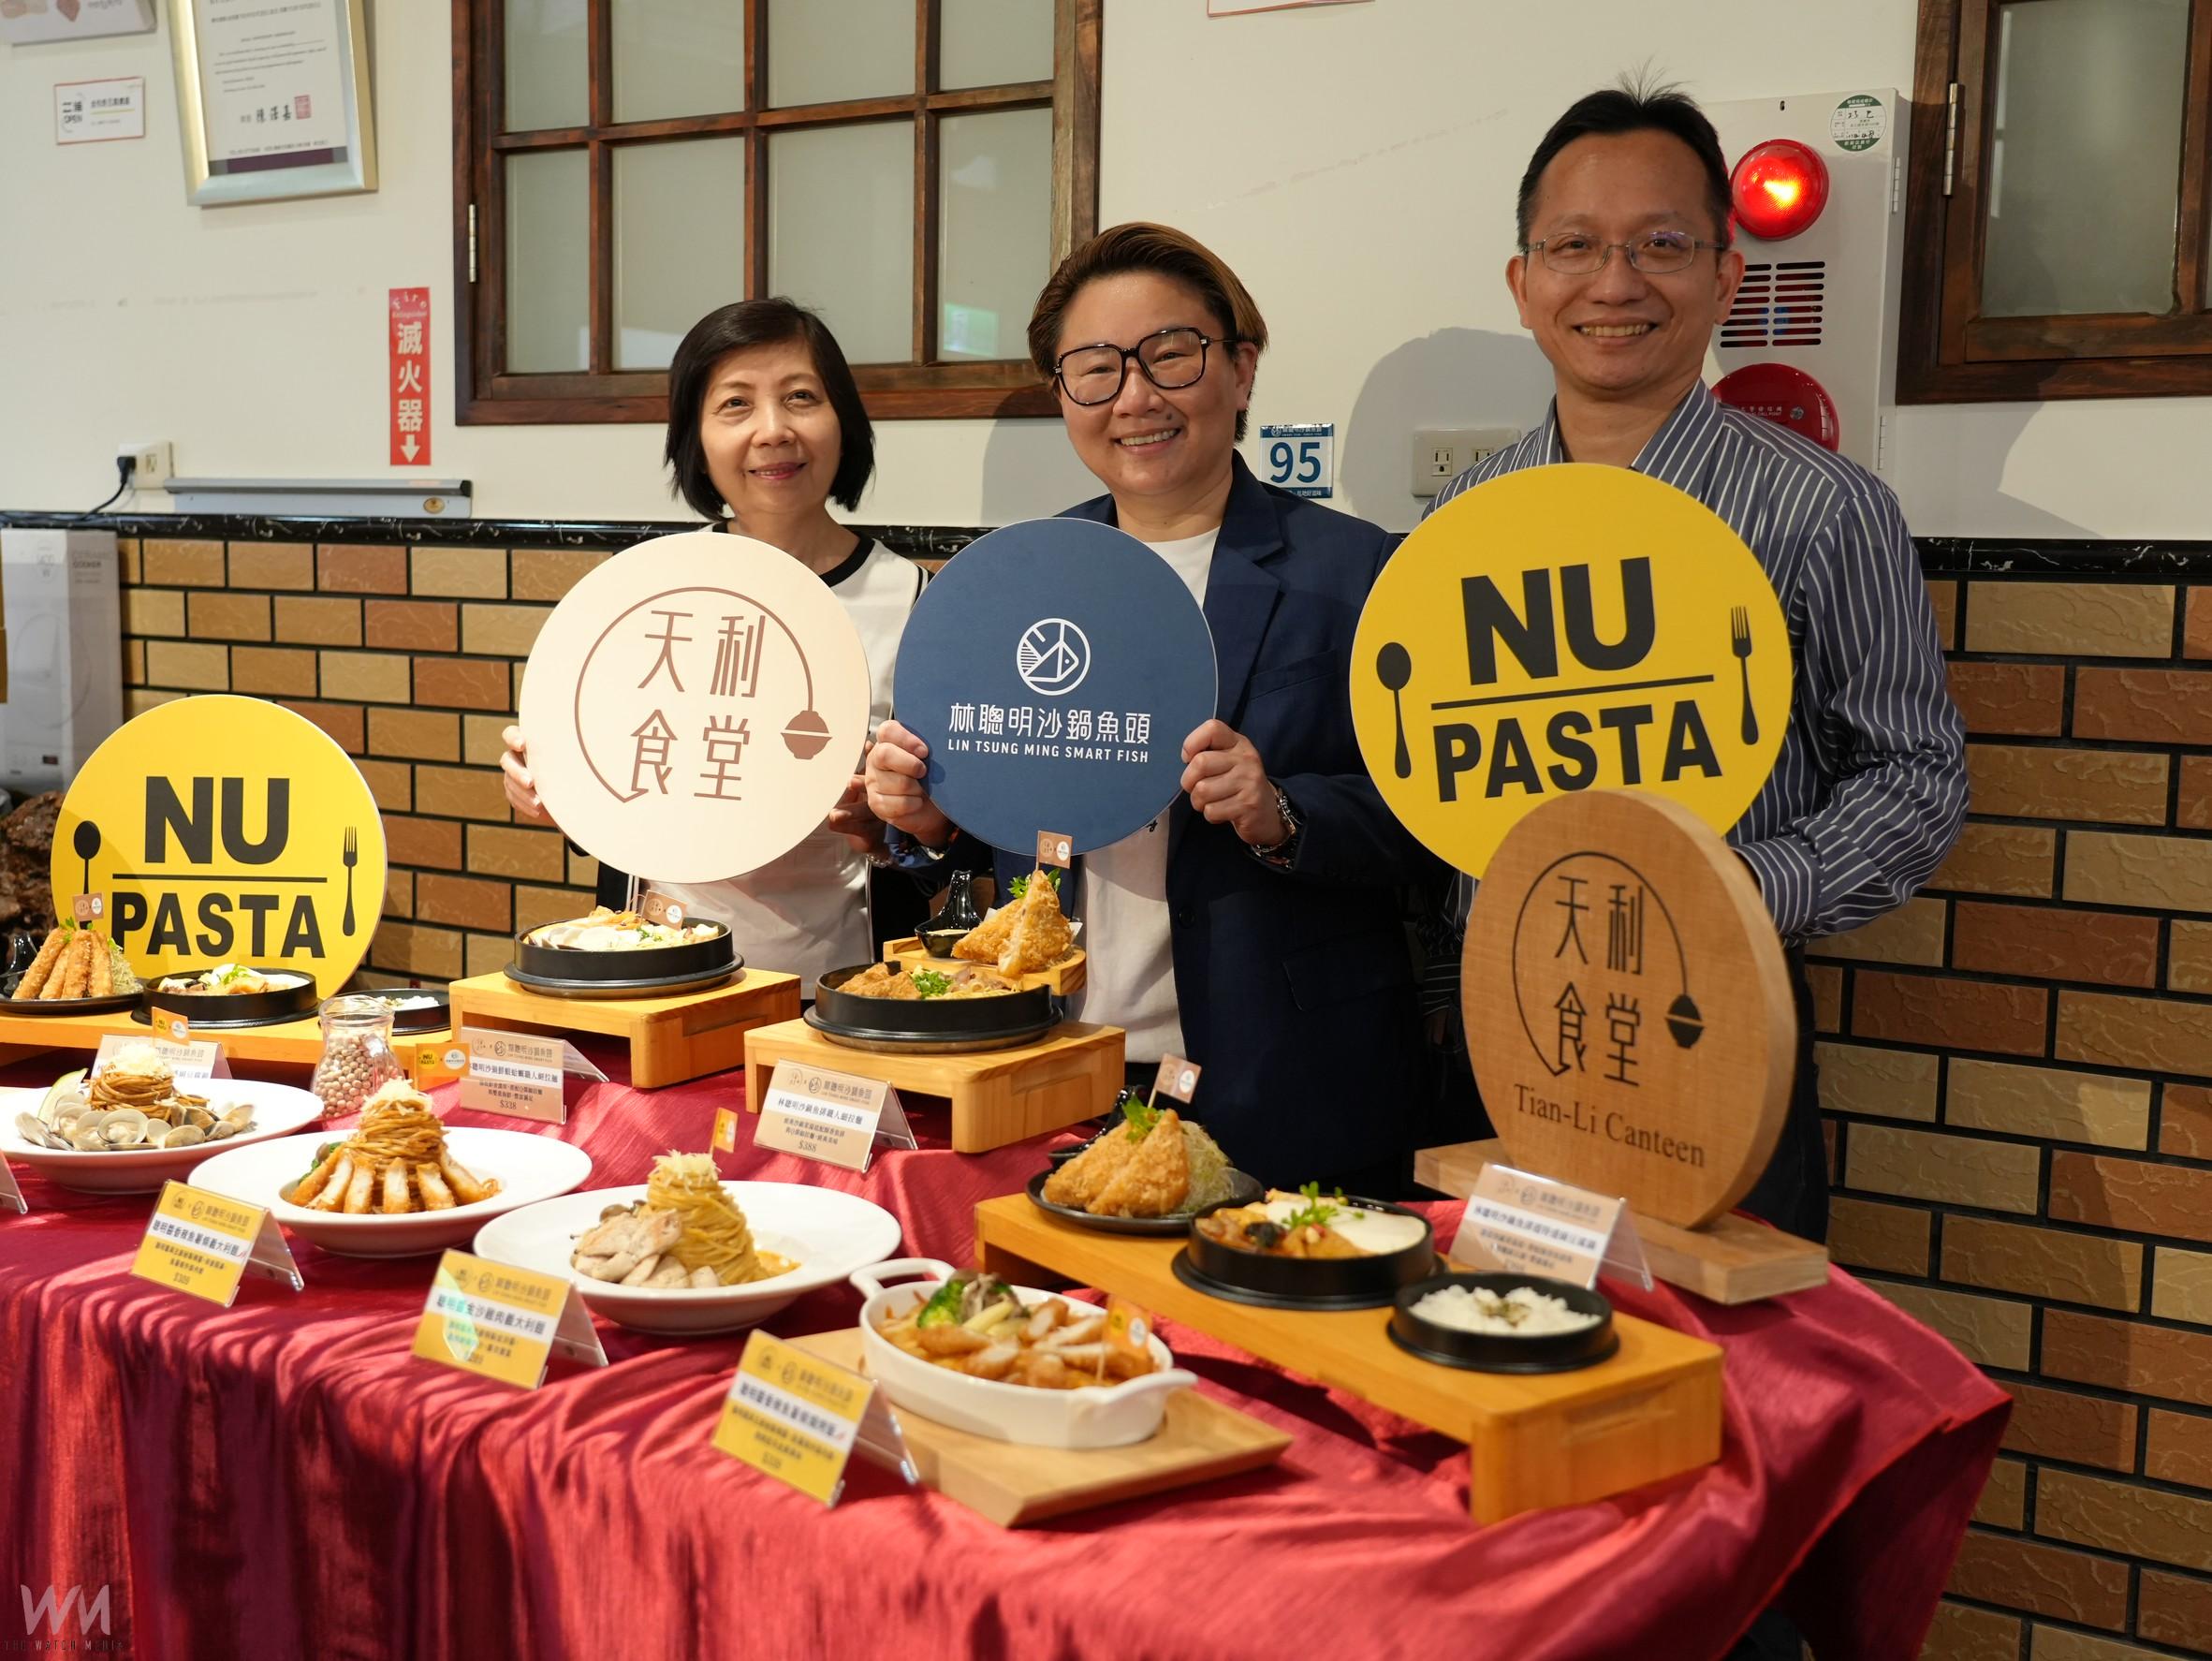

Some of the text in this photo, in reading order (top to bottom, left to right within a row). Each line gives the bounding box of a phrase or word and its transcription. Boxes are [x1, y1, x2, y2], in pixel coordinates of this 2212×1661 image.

[397, 321, 423, 433] 滅火器
[1269, 441, 1322, 484] 95
[637, 610, 767, 698] 天利
[1460, 556, 1656, 686] NU
[630, 709, 751, 801] 食堂
[947, 739, 1149, 763] LIN TSUNG MING SMART FISH
[948, 702, 1151, 745] 林聰明沙鍋魚頭
[1433, 699, 1723, 803] PASTA
[144, 775, 290, 865] NU
[110, 891, 326, 959] PASTA
[1554, 875, 1644, 976] 天利
[1553, 981, 1641, 1087] 食堂
[499, 1099, 517, 1110] $338
[798, 1140, 817, 1153] $388
[1513, 1083, 1706, 1169] Tian-Li Canteen
